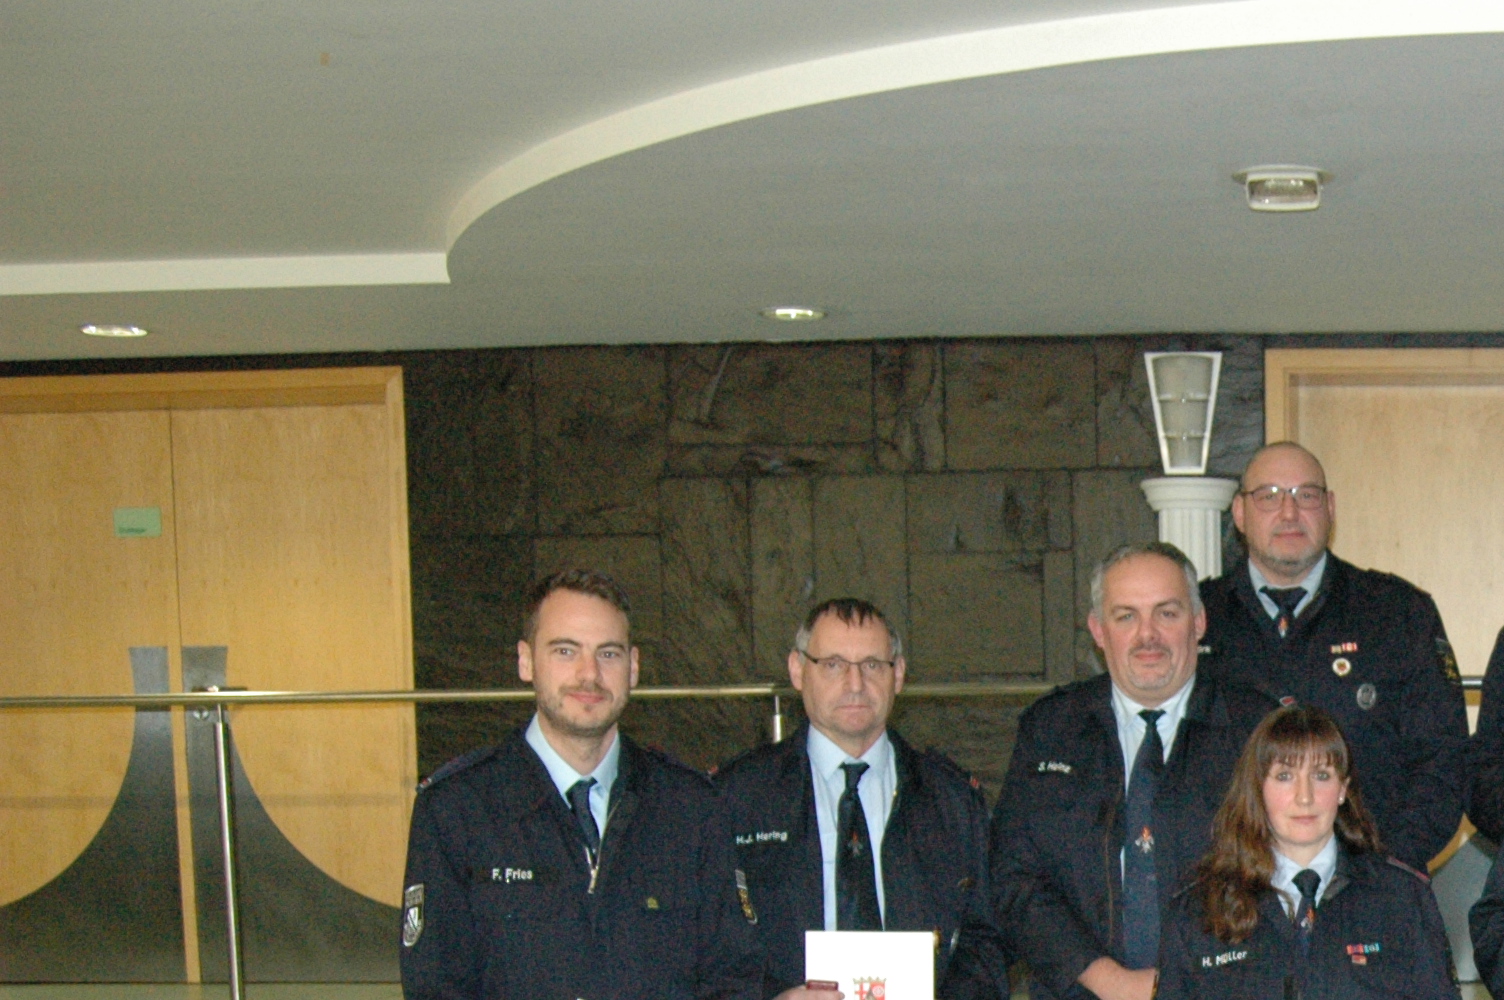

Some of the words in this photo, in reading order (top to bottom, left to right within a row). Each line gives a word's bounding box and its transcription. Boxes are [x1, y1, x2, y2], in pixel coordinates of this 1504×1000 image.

[492, 868, 502, 880] F.
[505, 868, 533, 880] Fries
[1202, 956, 1213, 967] H.
